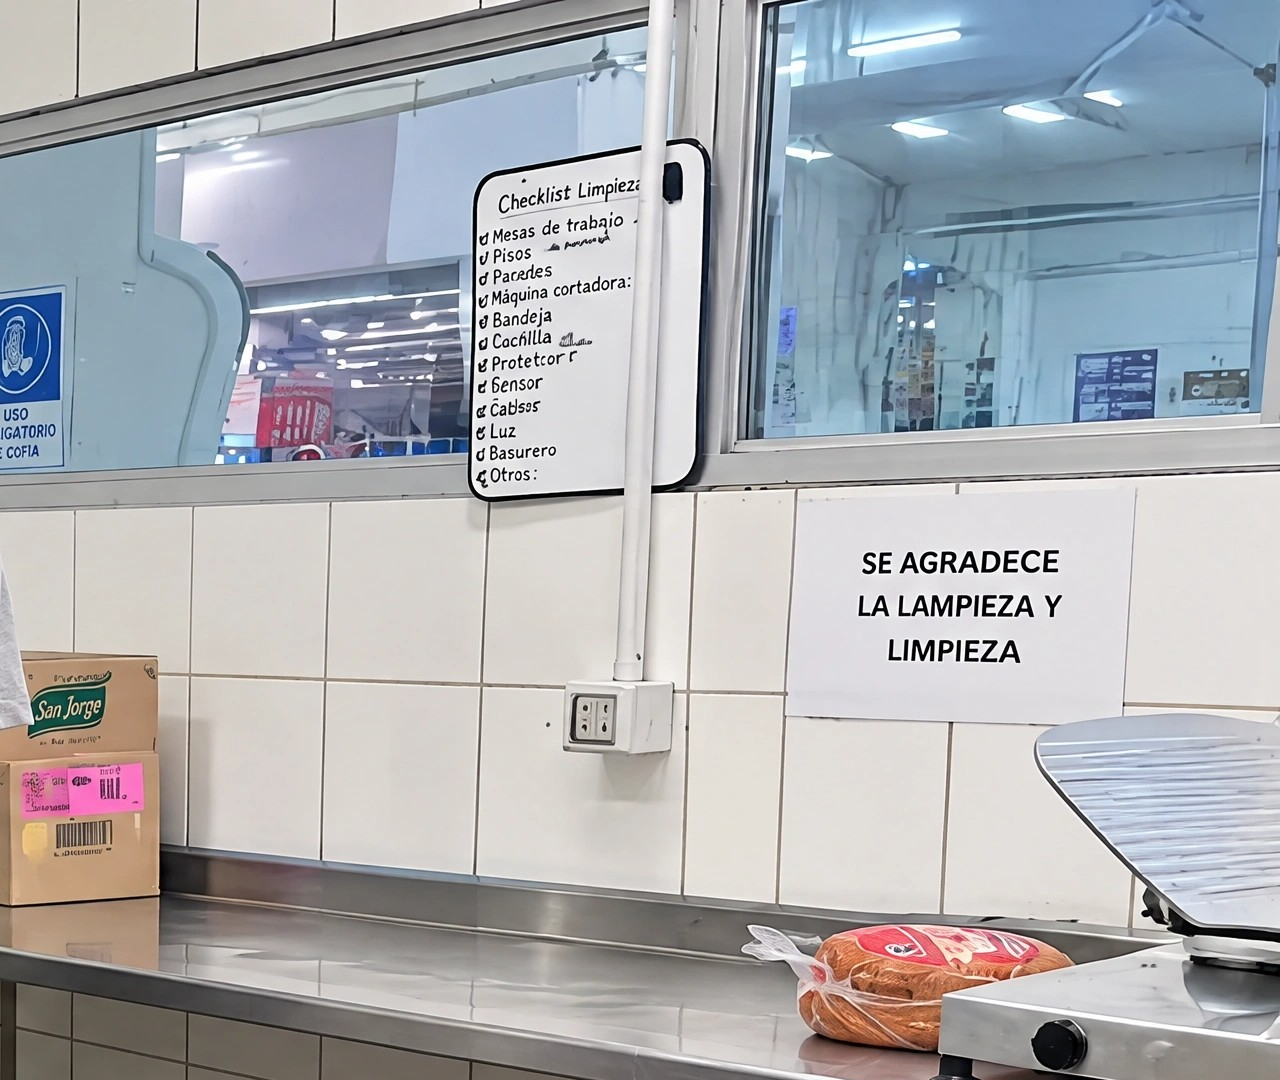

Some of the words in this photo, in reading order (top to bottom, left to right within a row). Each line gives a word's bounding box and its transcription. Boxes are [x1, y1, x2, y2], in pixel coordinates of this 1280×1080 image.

[499, 185, 572, 214] Checklist
[493, 227, 535, 243] Mesas
[542, 220, 559, 235] de
[494, 248, 532, 264] Pisos
[492, 287, 548, 308] Máquina
[493, 308, 551, 327] Bandeja
[4, 408, 28, 421] USO
[491, 423, 516, 438] Luz
[7, 445, 39, 458] COFIA
[490, 445, 556, 460] Basurero
[862, 552, 892, 574] SE
[900, 550, 1059, 574] AGRADECE
[859, 595, 889, 616] LA
[899, 595, 1034, 617] LAMPIEZA
[1045, 595, 1062, 617] Y
[889, 639, 1020, 663] LIMPIEZA
[35, 700, 62, 721] San
[63, 695, 102, 720] Jorge
